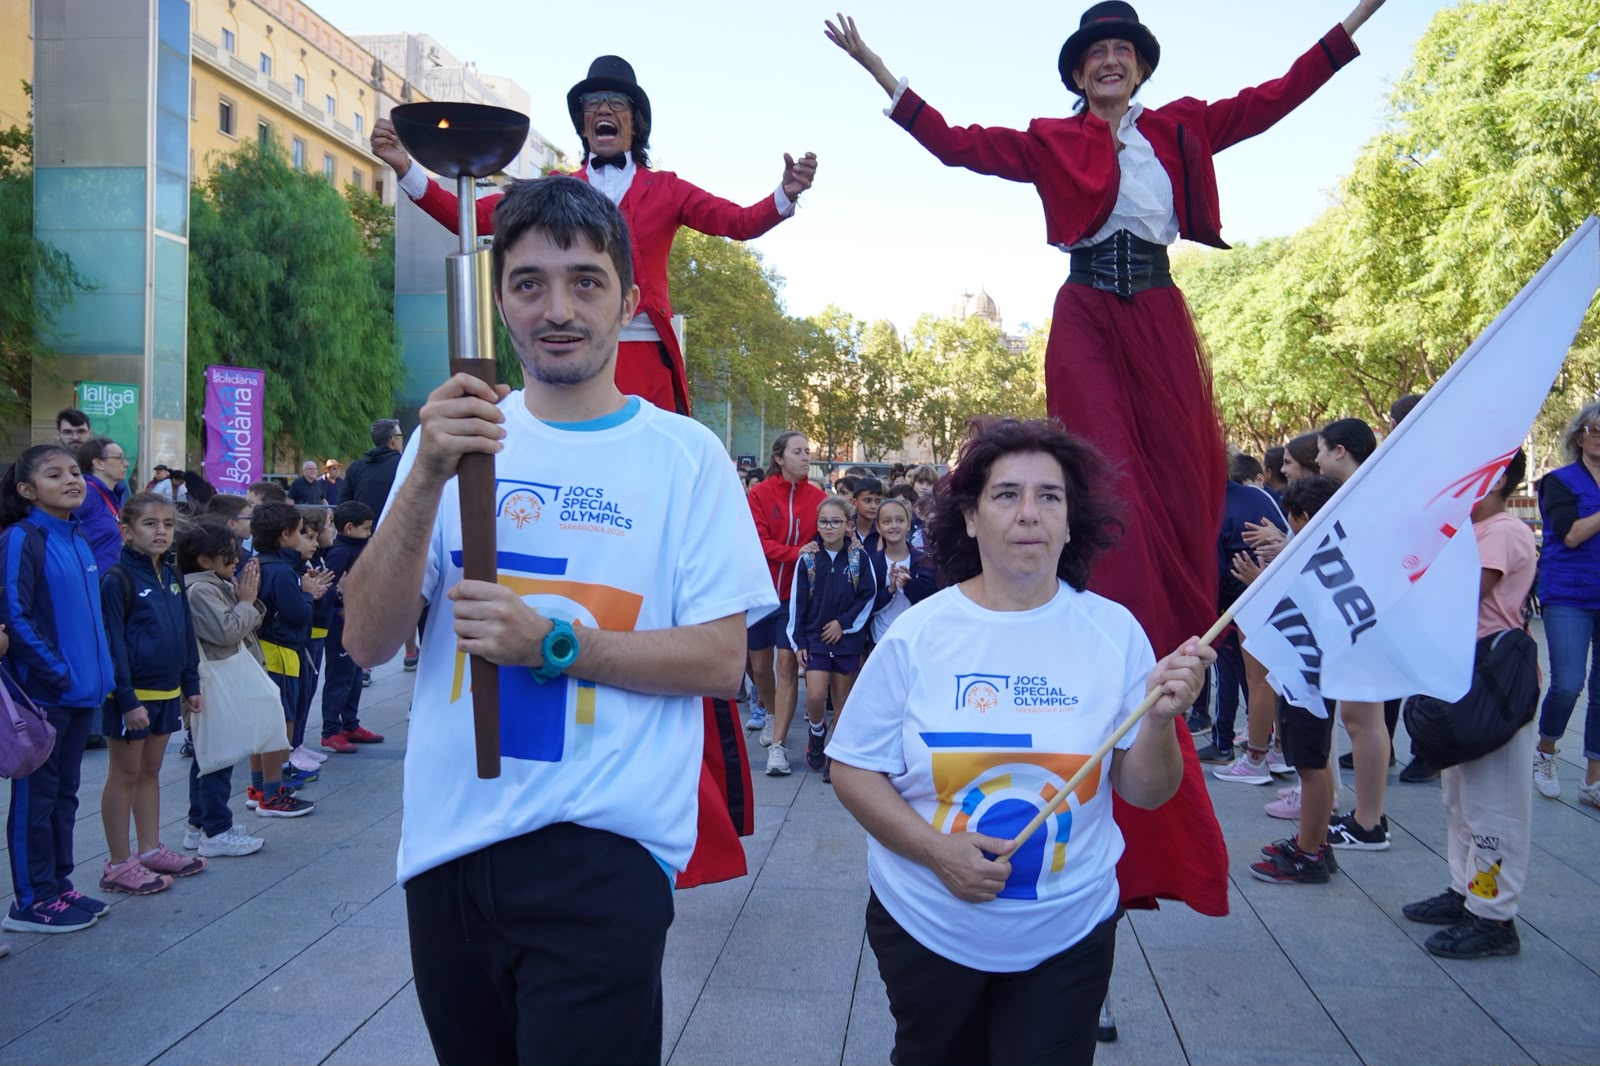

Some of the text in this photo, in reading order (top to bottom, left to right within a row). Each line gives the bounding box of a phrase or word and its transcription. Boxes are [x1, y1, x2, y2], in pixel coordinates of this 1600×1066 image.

[564, 485, 604, 499] JOCS
[561, 497, 622, 515] SPECIAL
[559, 509, 633, 530] OLYMPICS
[559, 523, 606, 533] TARRAGONA
[1013, 675, 1048, 687] JOCS
[1013, 686, 1067, 697] SPECIAL
[1013, 696, 1079, 707] OLYMPICS
